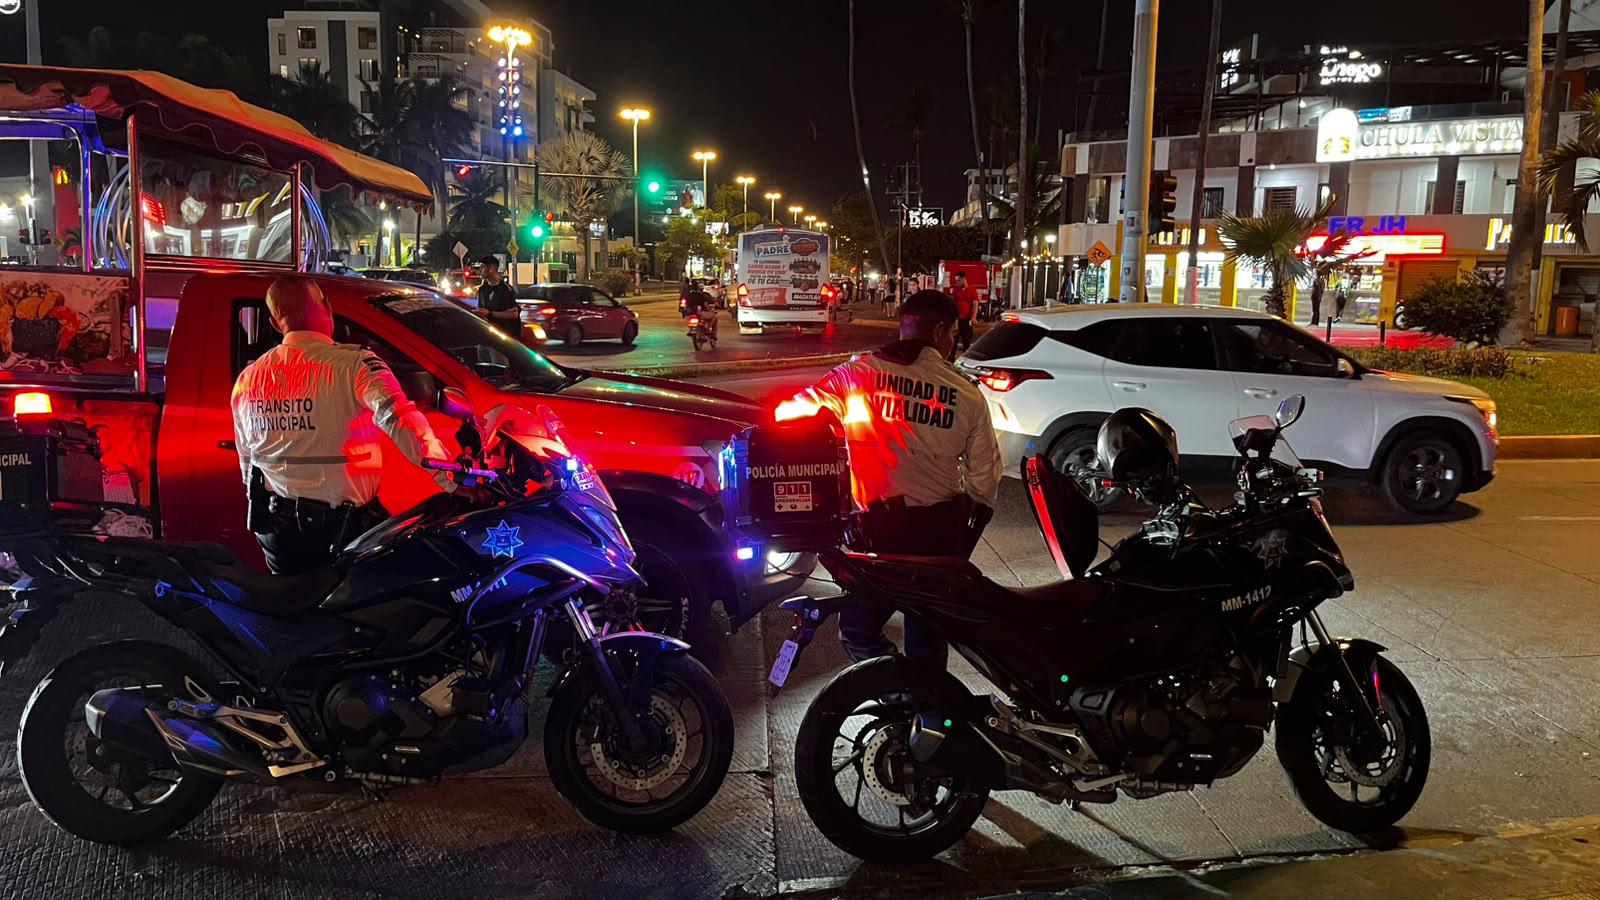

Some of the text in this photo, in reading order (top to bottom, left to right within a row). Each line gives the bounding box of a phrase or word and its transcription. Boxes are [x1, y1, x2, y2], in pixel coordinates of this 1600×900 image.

[1361, 118, 1523, 147] CHULA VISTA
[1372, 215, 1406, 234] JH
[756, 245, 789, 256] PADRE
[876, 373, 958, 406] UNIDAD DE
[251, 416, 316, 431] MUNICIPAL
[746, 463, 840, 479] POLICÍA MUNICIPAL
